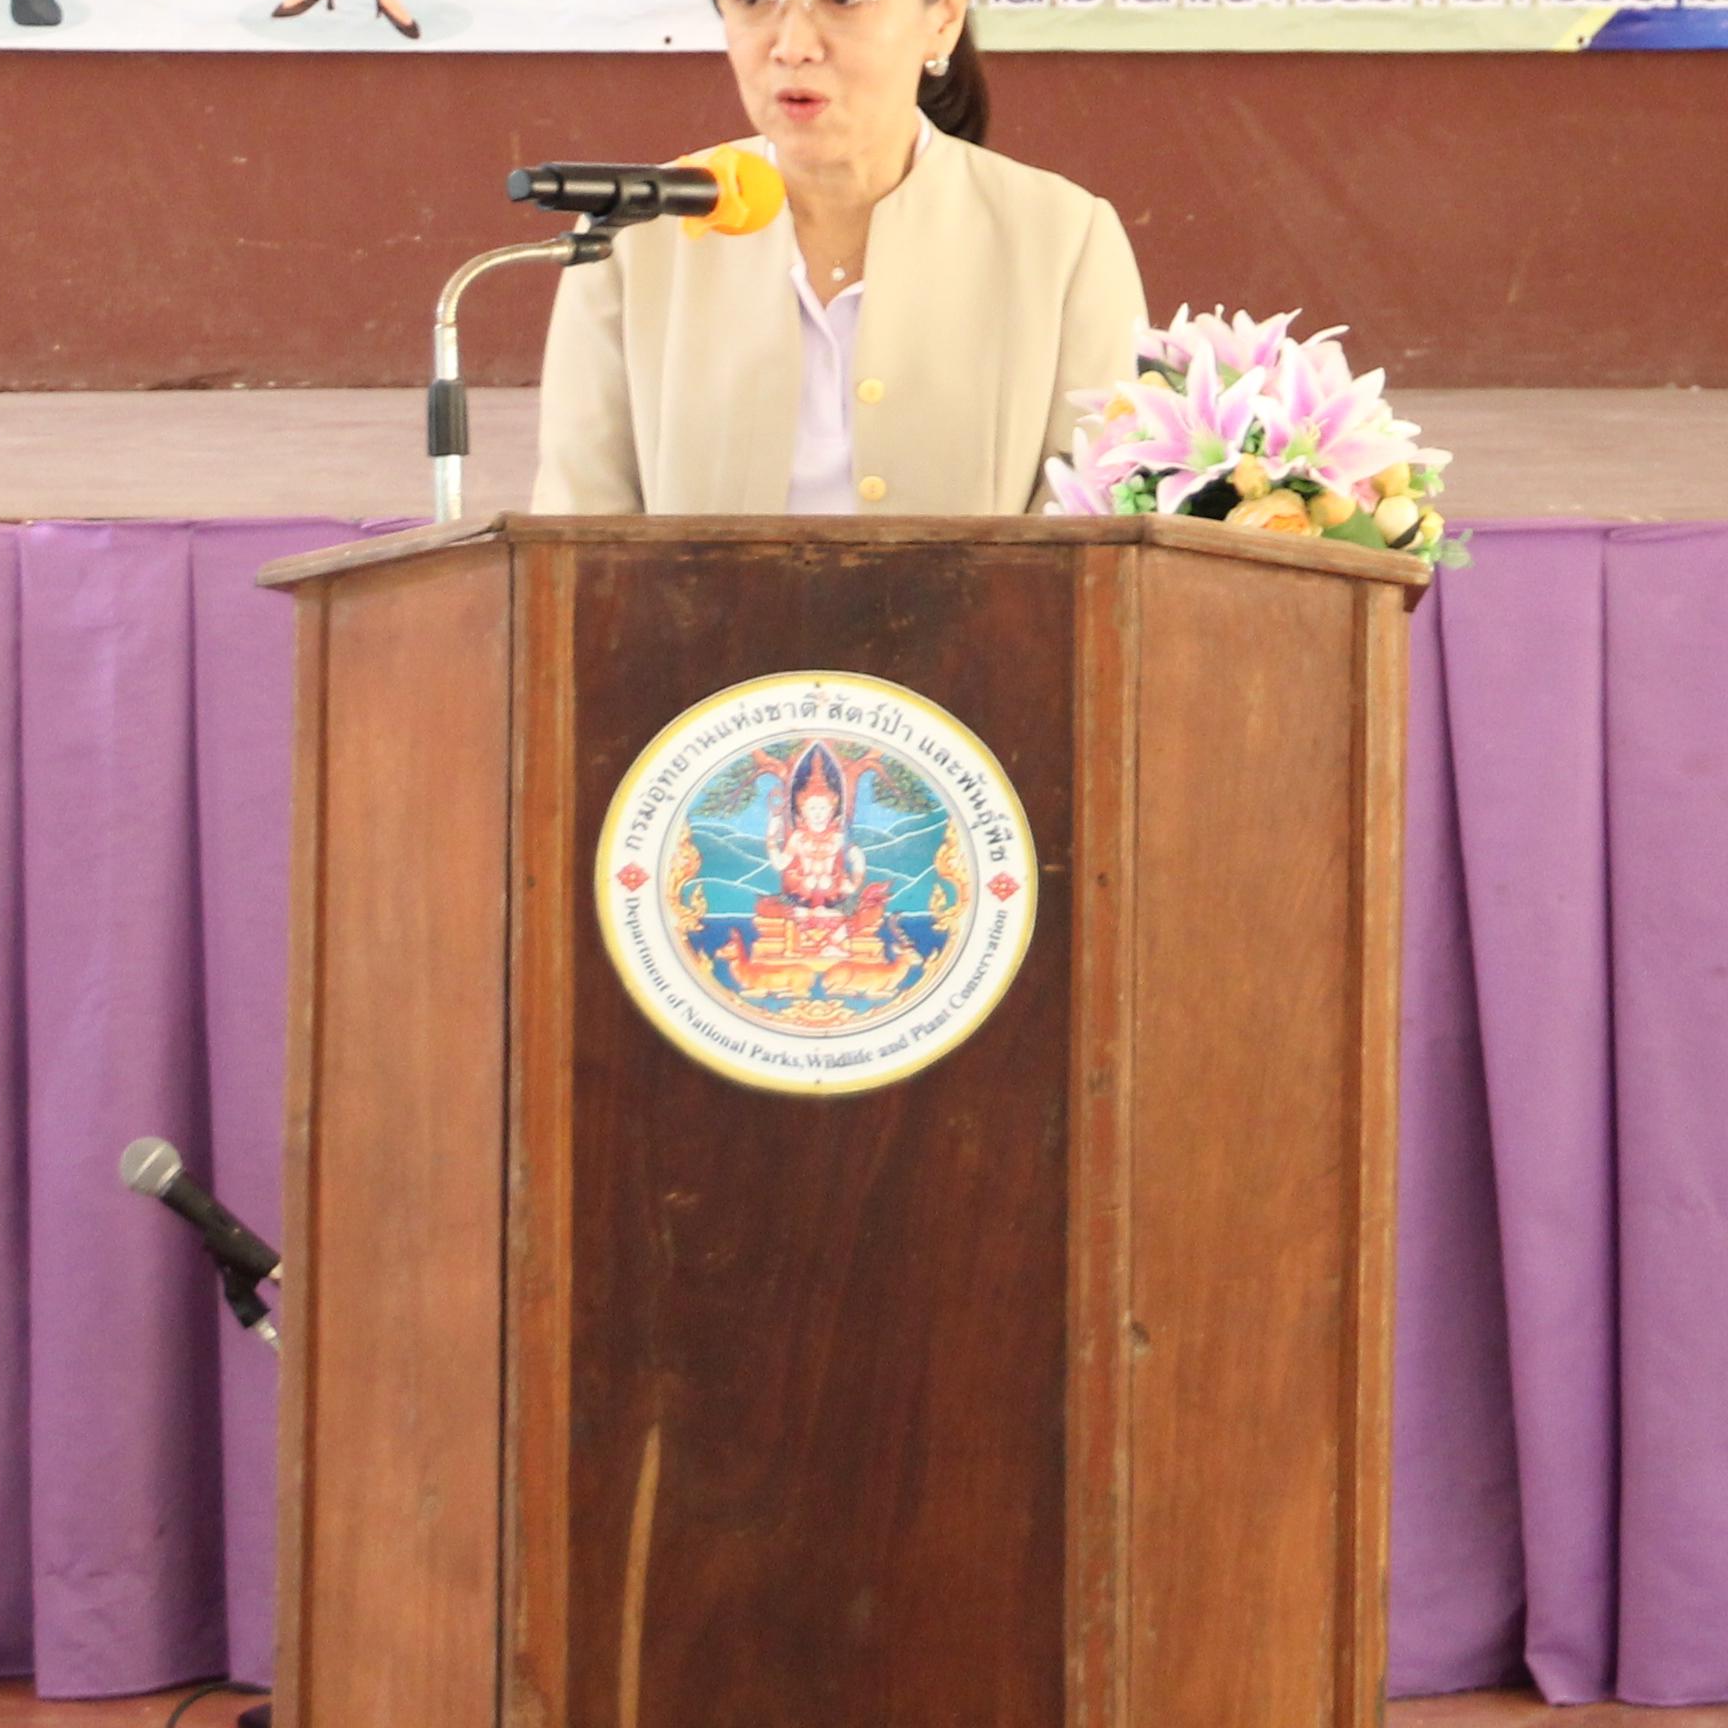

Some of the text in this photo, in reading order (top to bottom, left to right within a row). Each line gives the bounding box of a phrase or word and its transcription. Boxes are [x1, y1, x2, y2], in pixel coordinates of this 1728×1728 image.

[625, 692, 1014, 863] กรมอุทยานแห่งชาติ สัตว์ป่า และพันธุ์พืช
[625, 895, 670, 993] Department
[666, 993, 686, 1011] of
[681, 1005, 749, 1055] National
[878, 1034, 910, 1058] and
[910, 1006, 953, 1043] Plant
[948, 908, 1009, 1011] Conservation
